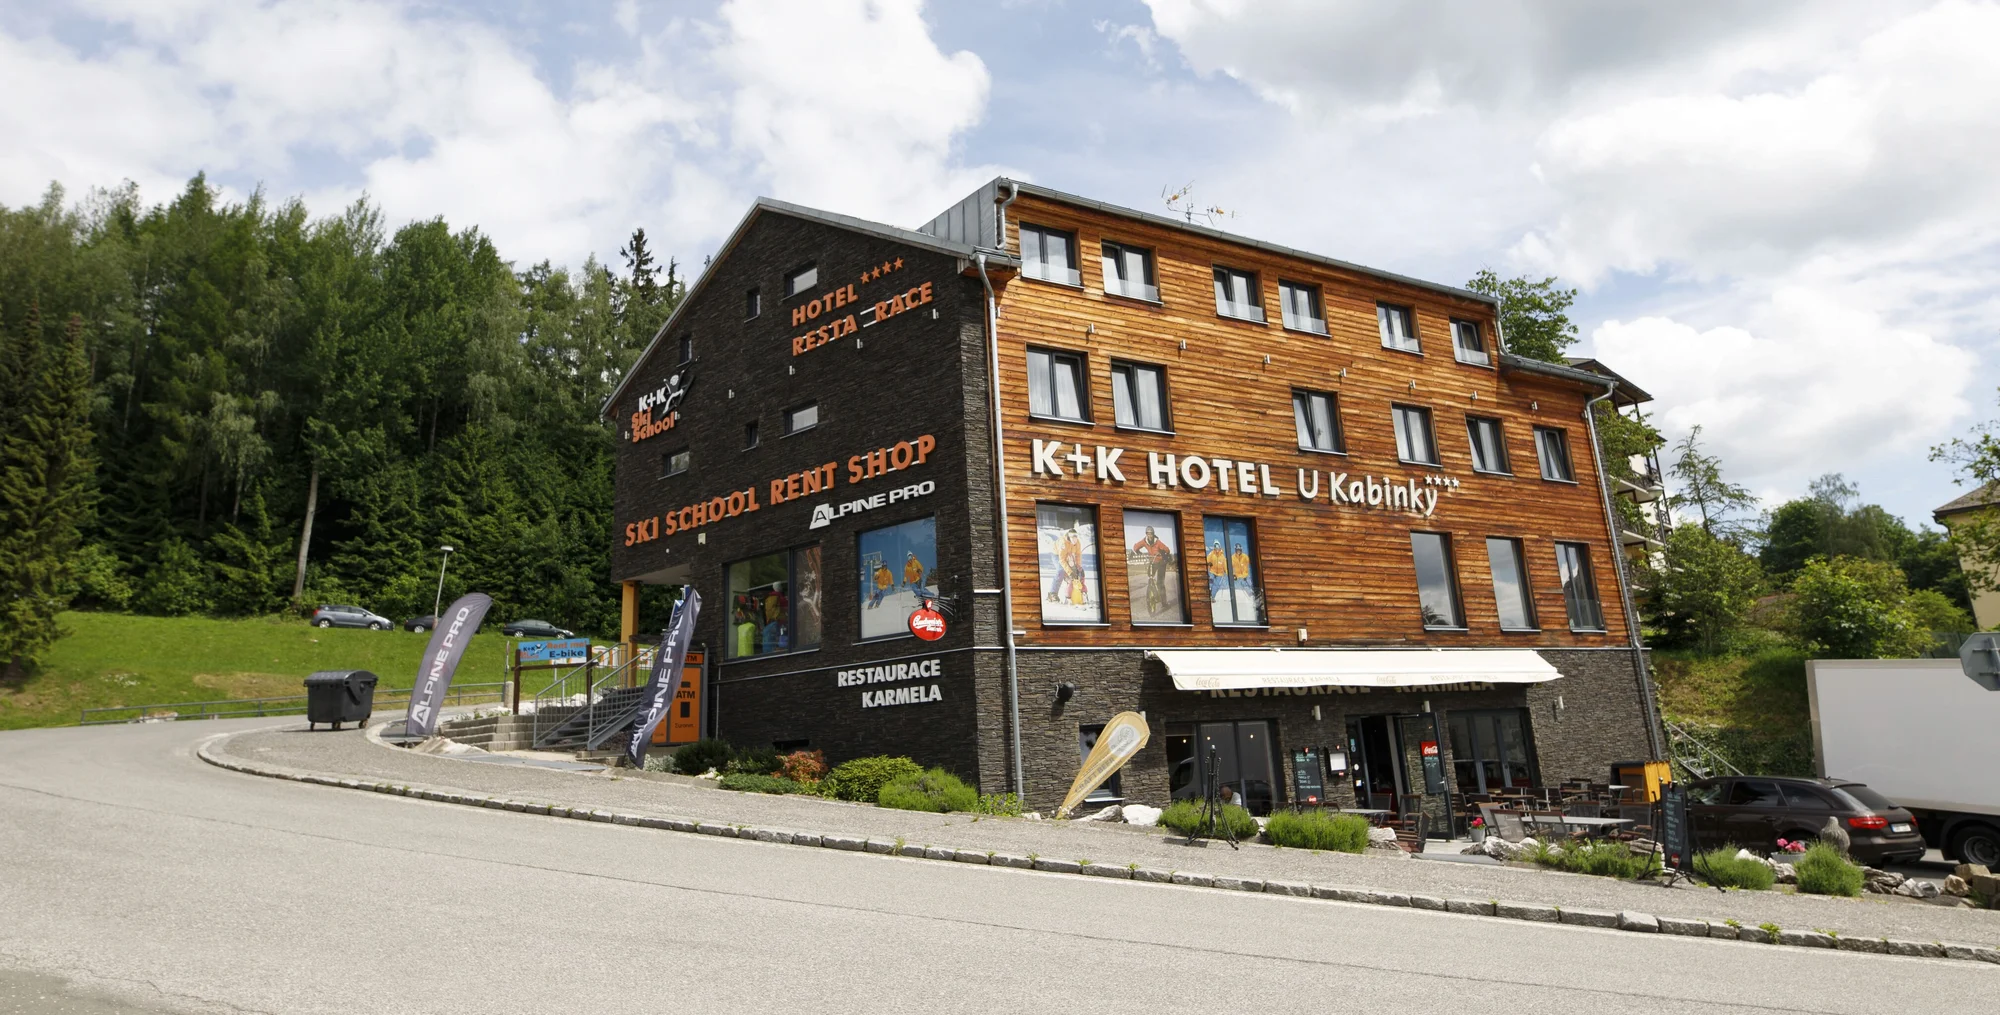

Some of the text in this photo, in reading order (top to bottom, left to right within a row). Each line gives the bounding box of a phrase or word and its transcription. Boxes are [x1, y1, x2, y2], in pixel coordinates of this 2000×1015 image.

[792, 283, 859, 327] HOTEL
[639, 386, 666, 412] K+K
[624, 433, 936, 547] SKI SCHOOL RENT SHOP
[1031, 438, 1438, 517] K+K HOTEL U Kabinky
[808, 480, 936, 530] ALPINE PRO
[411, 607, 470, 728] ALPINE PRO
[549, 648, 584, 658] E-bike
[837, 659, 941, 688] RESTAURACE
[676, 690, 696, 699] ATM
[862, 684, 943, 708] KARMELA
